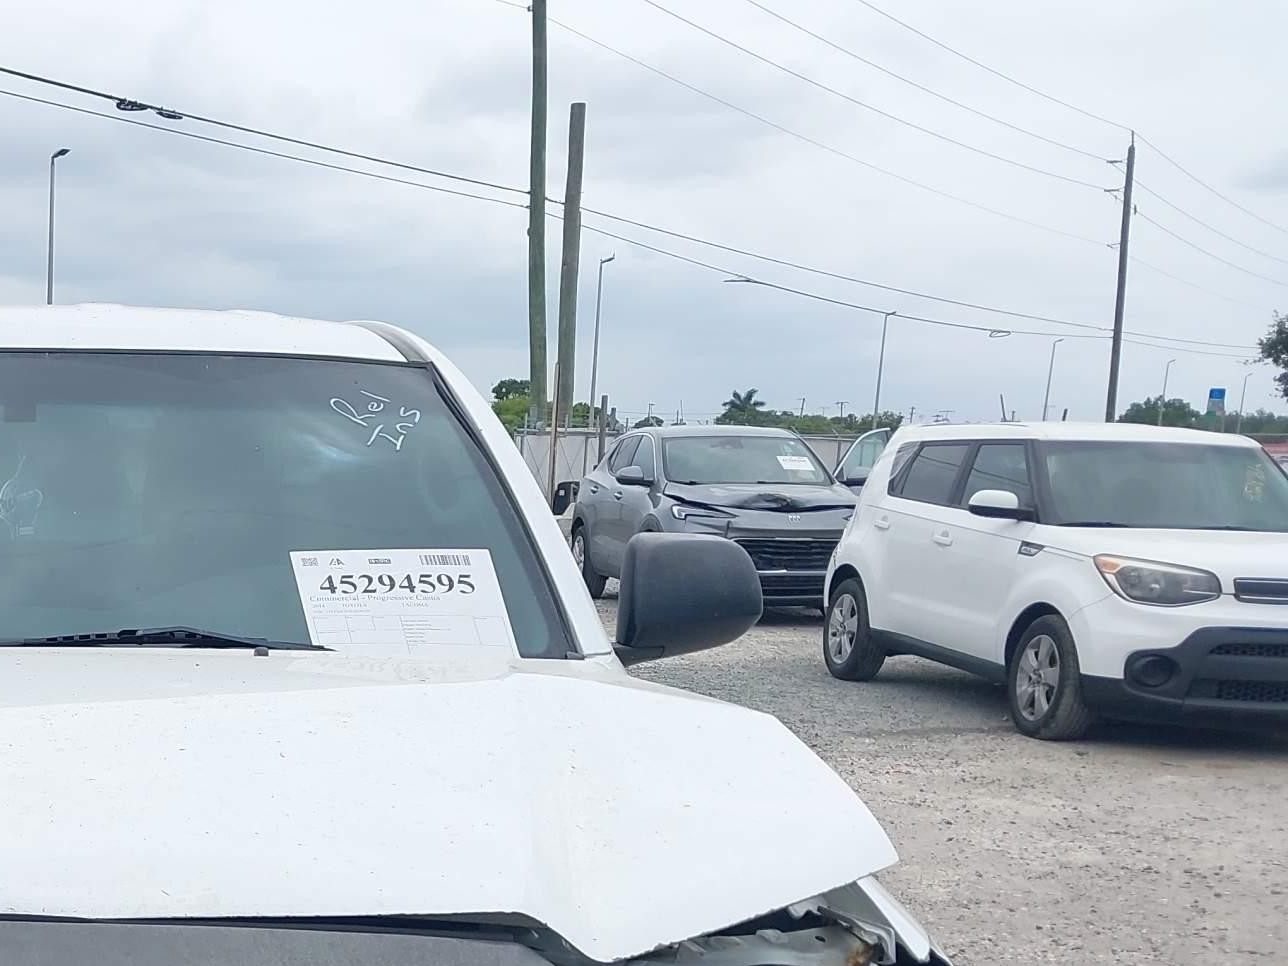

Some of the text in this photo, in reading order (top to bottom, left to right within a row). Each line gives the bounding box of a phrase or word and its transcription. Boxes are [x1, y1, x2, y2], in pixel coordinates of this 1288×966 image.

[367, 406, 421, 451] Ins
[319, 573, 476, 595] 45294595
[367, 594, 415, 603] Progressive
